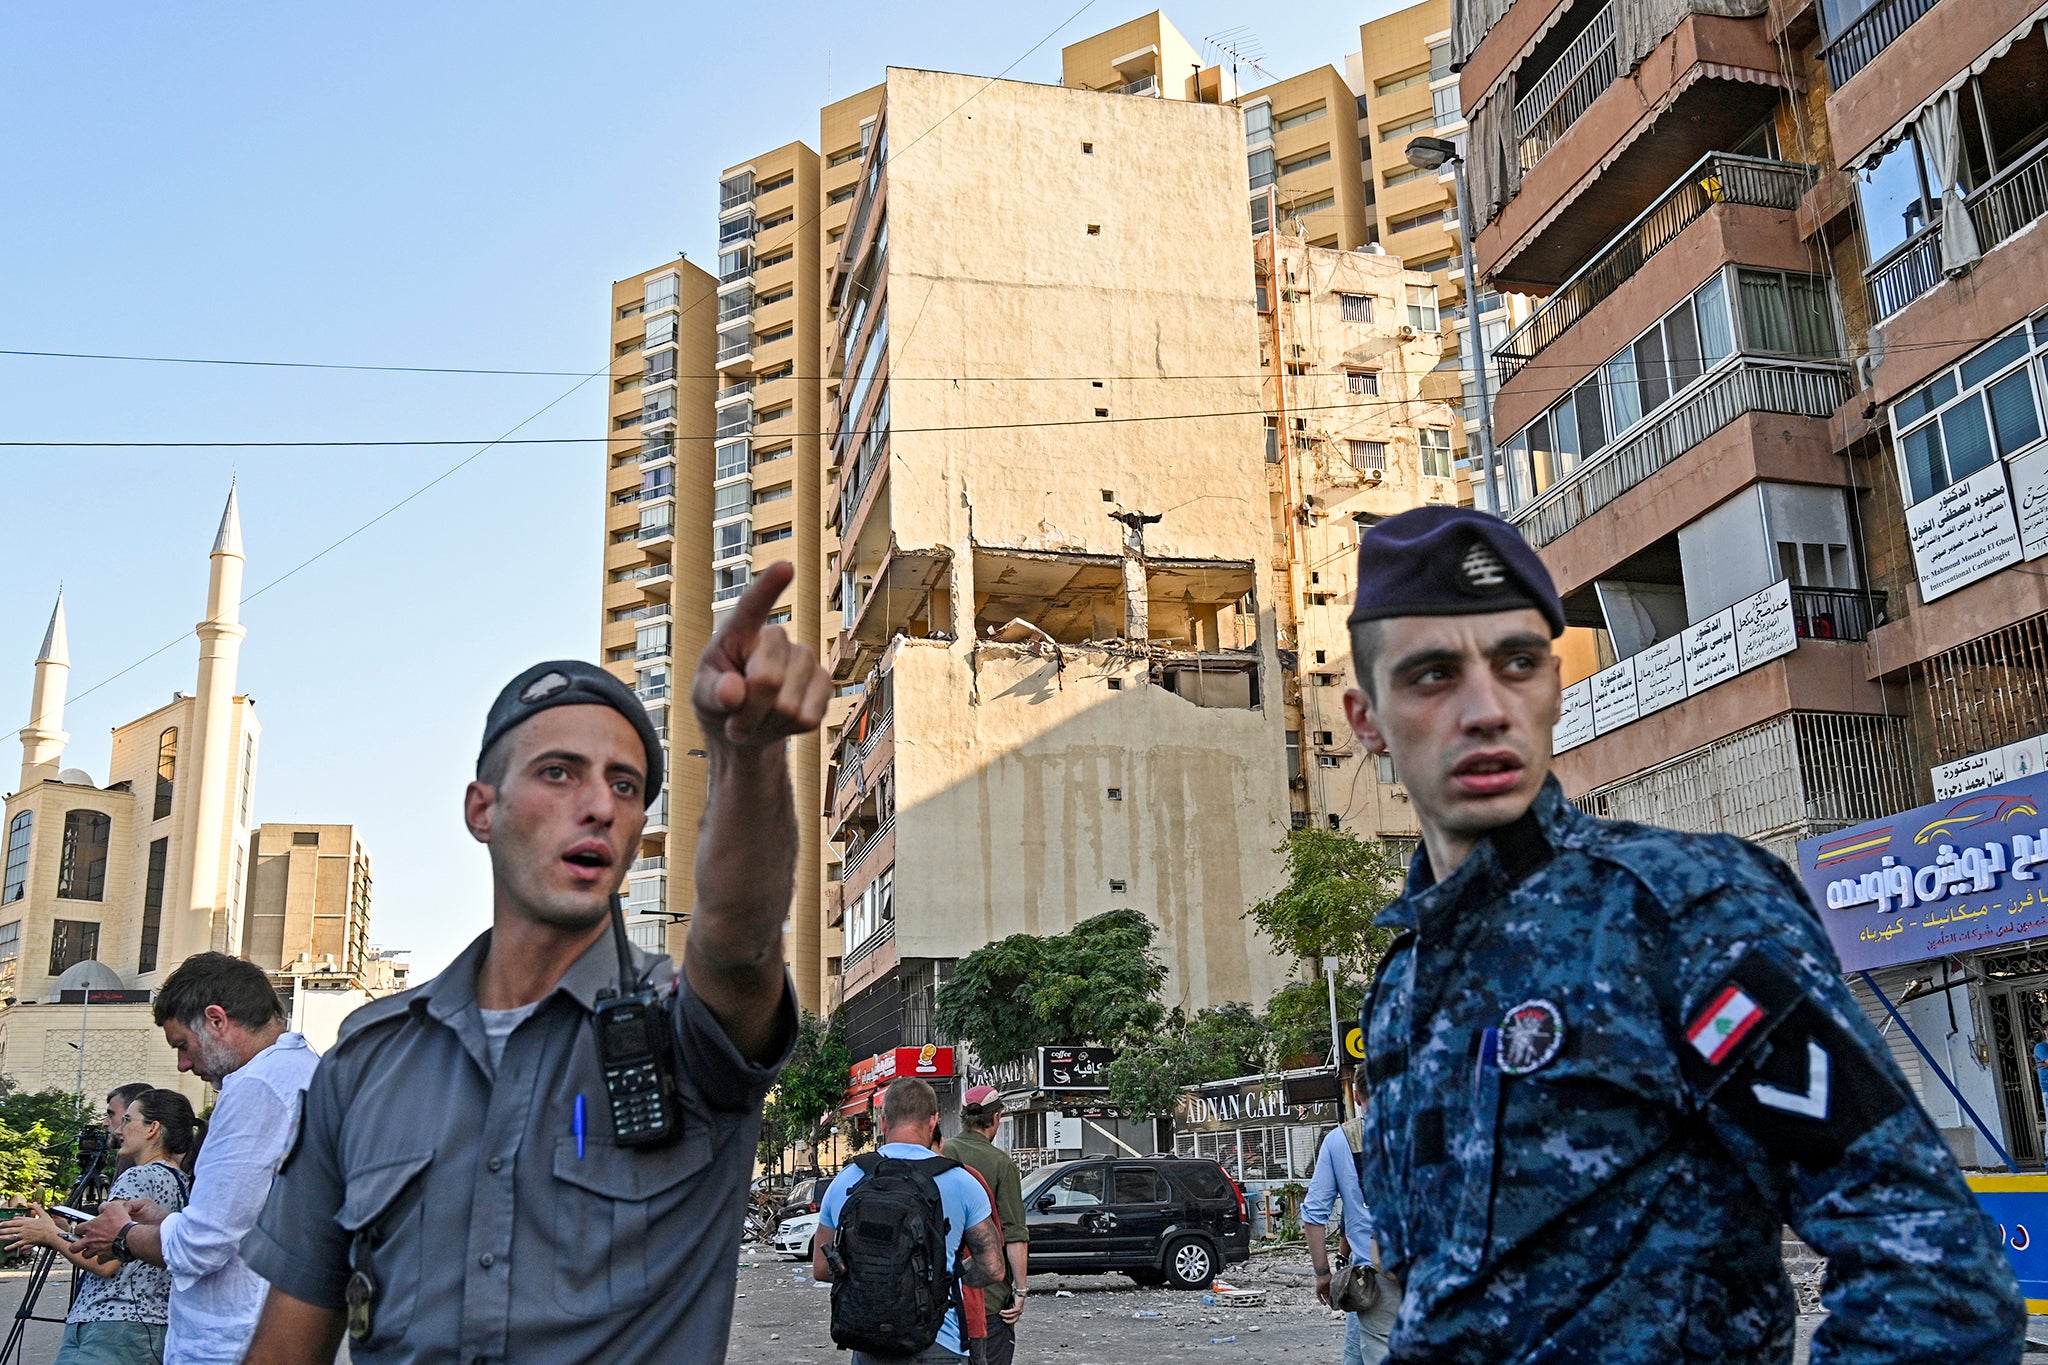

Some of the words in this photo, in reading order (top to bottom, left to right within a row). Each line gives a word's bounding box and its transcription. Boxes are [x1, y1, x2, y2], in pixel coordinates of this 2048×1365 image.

[1938, 481, 1971, 511] الدكتور
[1974, 485, 2006, 508] محمود
[1937, 502, 1972, 528] مصطفى
[1912, 518, 1936, 541] الغول
[1920, 574, 1931, 583] Dr.
[1931, 559, 1961, 577] Mahmoud
[1961, 547, 1987, 563] Mostafa
[1987, 542, 1996, 552] El
[1995, 533, 2017, 547] Ghoul
[1929, 566, 1972, 592] Interventional
[1972, 550, 2012, 572] Cardiologist
[1695, 618, 1721, 642] الدكتور
[1710, 631, 1732, 650] موسى
[1686, 641, 1708, 662] عليوان
[1942, 756, 1988, 780] الدكتورة
[1986, 768, 2004, 788] منال
[1965, 777, 1986, 791] محمد
[2007, 888, 2034, 915] فرن
[1922, 903, 1989, 929] ميكانيك
[1860, 917, 1905, 943] كهرباء
[1051, 1050, 1072, 1059] coffee
[1186, 1094, 1240, 1124] ADNAN
[1245, 1089, 1291, 1119] CAFE
